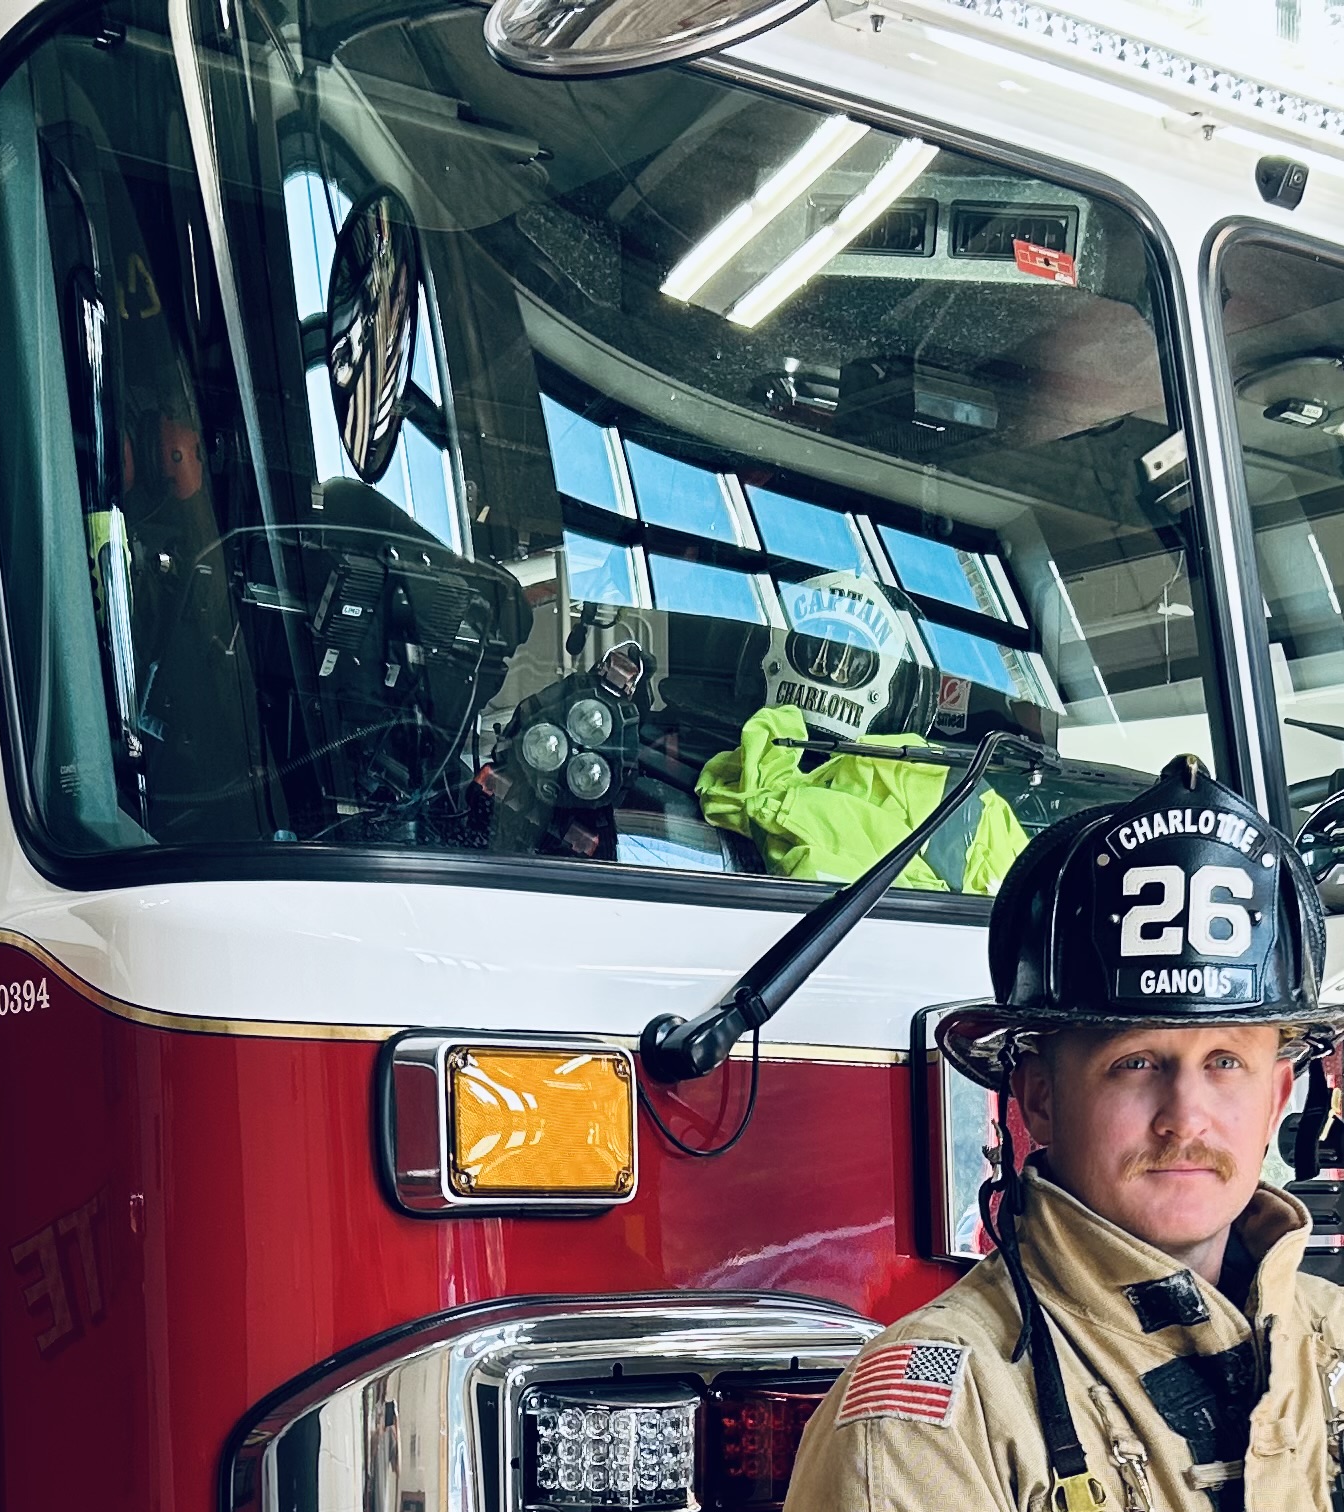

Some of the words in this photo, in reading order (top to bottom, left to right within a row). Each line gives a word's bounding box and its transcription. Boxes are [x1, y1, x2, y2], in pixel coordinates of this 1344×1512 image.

[794, 586, 893, 647] CAPTAIN
[776, 680, 864, 729] CHARLOTTE
[1119, 809, 1258, 853] CHARLOTTE
[1121, 865, 1254, 957] 26
[1140, 967, 1232, 996] GANOUS
